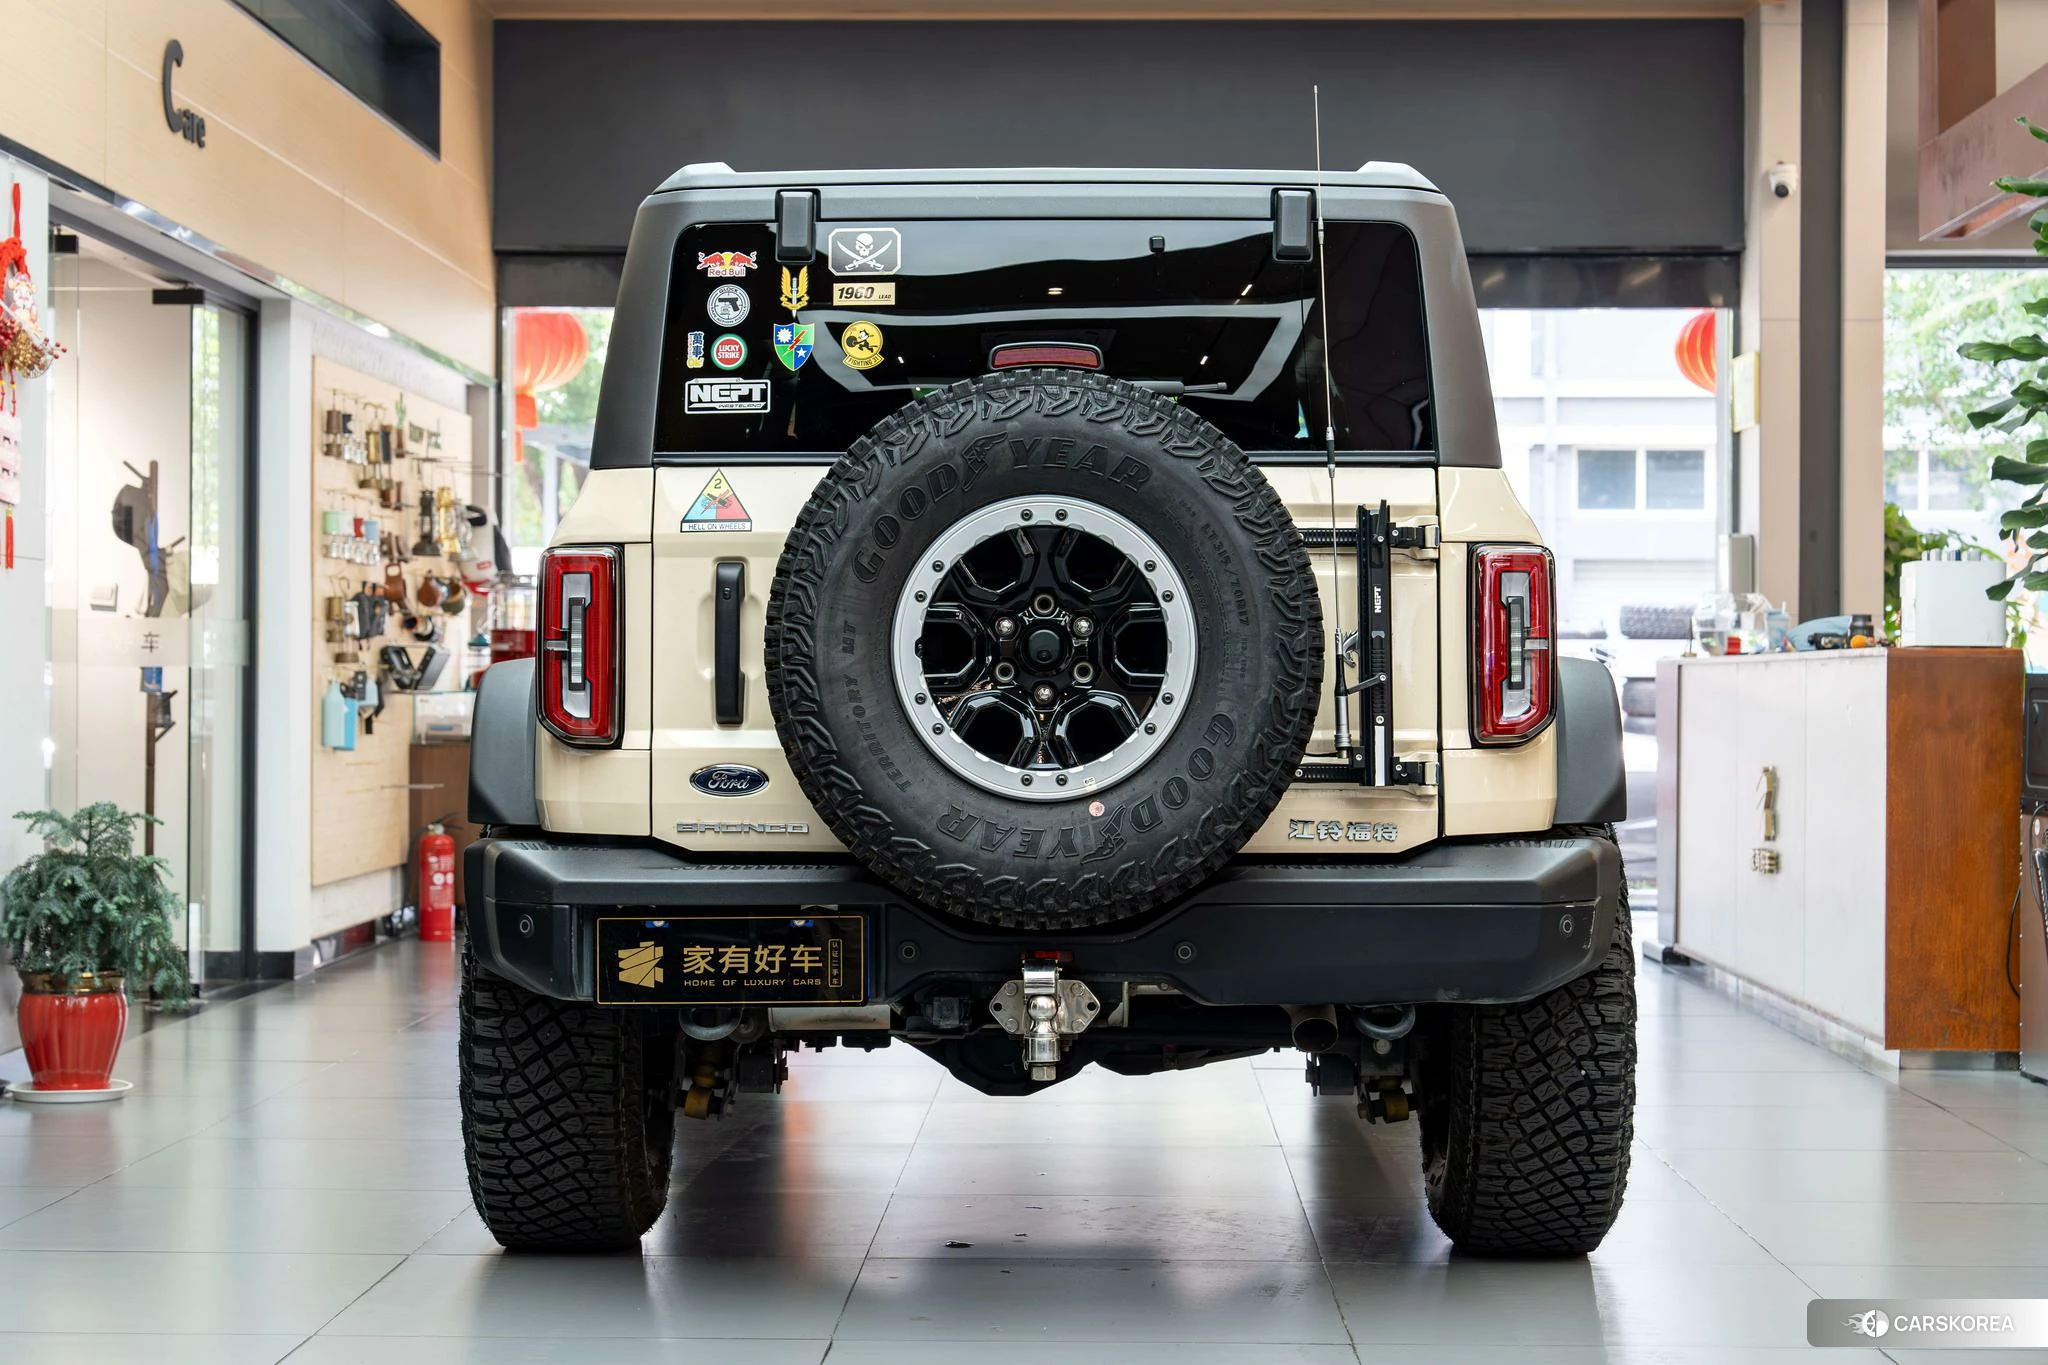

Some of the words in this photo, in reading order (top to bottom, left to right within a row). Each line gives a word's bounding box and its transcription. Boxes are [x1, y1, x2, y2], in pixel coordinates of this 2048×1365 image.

[162, 38, 206, 149] Care
[708, 268, 727, 276] Red
[728, 268, 745, 276] Bull
[838, 286, 875, 300] 1960
[717, 351, 740, 359] STRIKE
[719, 344, 740, 352] LUCKY
[848, 357, 874, 367] FIGHTING
[689, 383, 767, 402] NEPT
[713, 477, 722, 490] 2
[688, 522, 705, 531] HELL
[707, 522, 718, 531] ON
[719, 522, 746, 530] WHEELS
[1373, 585, 1382, 614] NEPT
[841, 619, 857, 655] MT
[842, 673, 914, 793] TERRITORY
[707, 770, 750, 790] Ford
[676, 822, 809, 834] BRONCO
[1288, 818, 1398, 842] 江铃福特
[682, 944, 823, 975] 家有好车
[683, 979, 716, 987] HOME
[722, 979, 738, 987] OF
[743, 978, 786, 986] LUXURY
[792, 978, 822, 986] CARS
